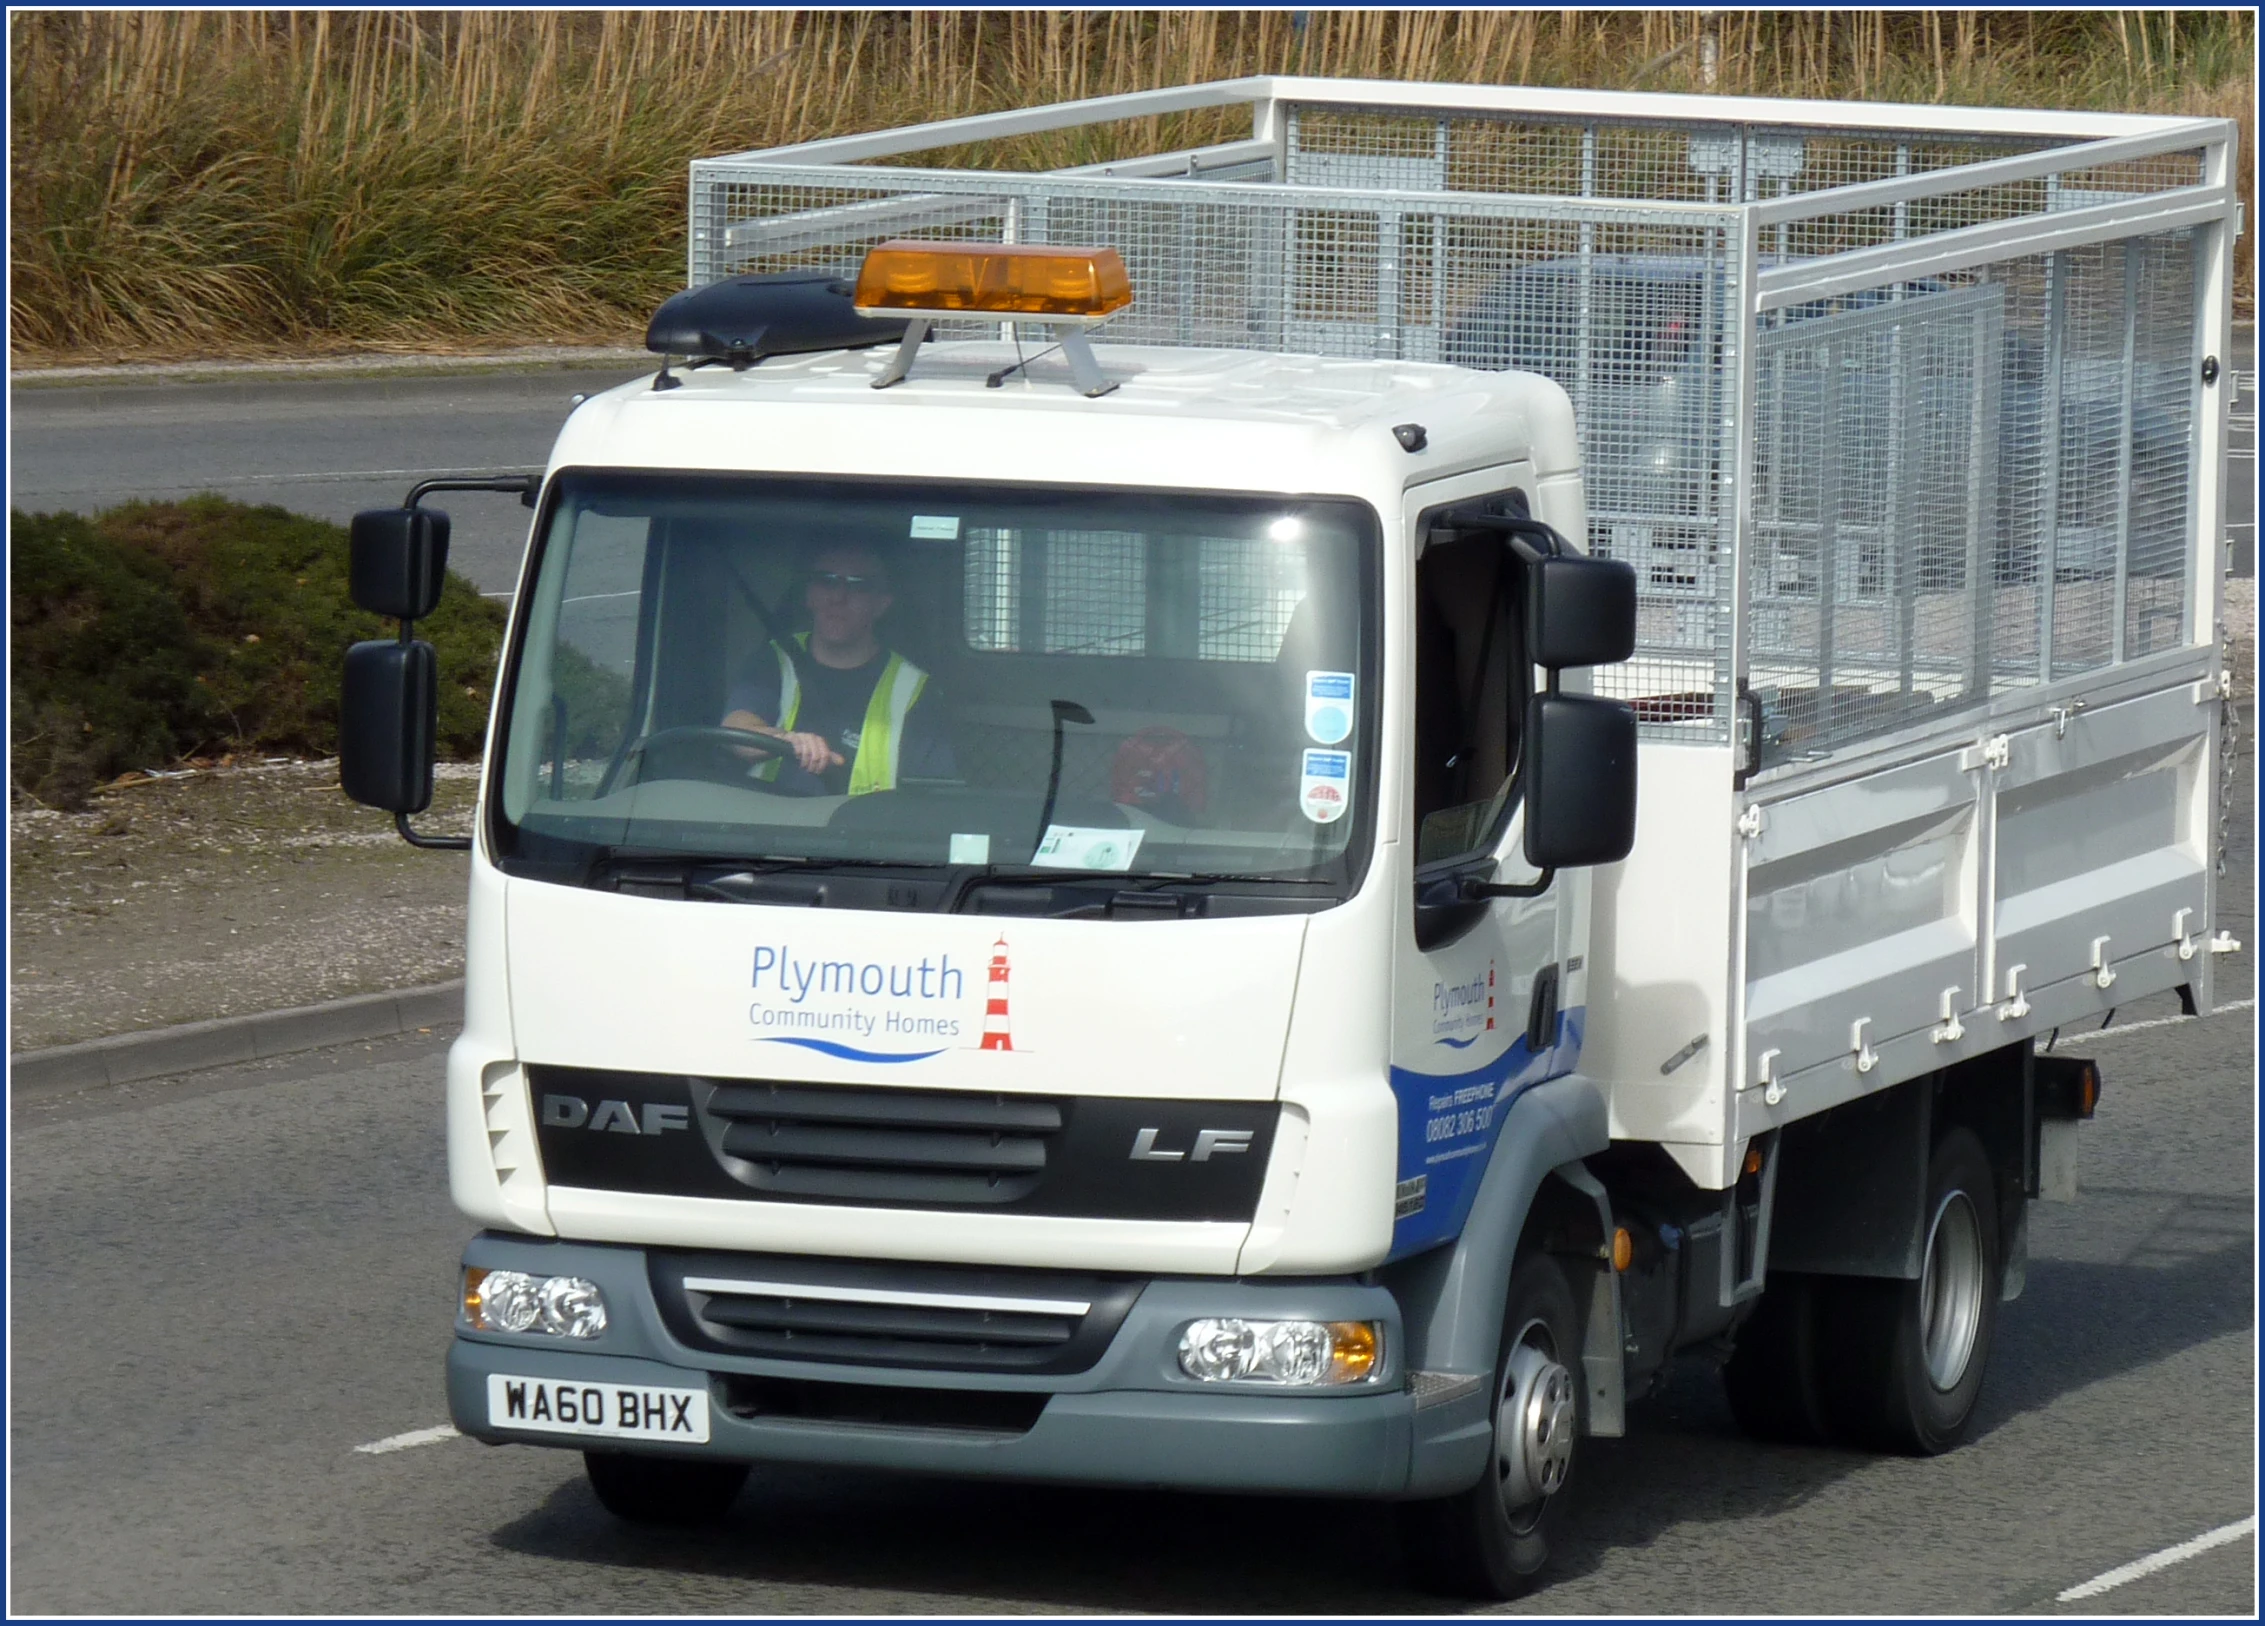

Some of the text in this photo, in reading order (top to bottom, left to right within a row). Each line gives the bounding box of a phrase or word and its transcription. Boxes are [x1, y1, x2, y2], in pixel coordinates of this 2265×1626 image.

[751, 945, 963, 1003] Plymouth
[1434, 973, 1485, 1017] Plymouth
[749, 1003, 960, 1037] Community Homes
[543, 1094, 689, 1136] DAF
[1429, 1082, 1495, 1112] Repairs FREEPHONE
[1128, 1128, 1254, 1161] LF
[1426, 1114, 1456, 1143] 08082
[1457, 1109, 1475, 1135] 306
[505, 1381, 693, 1432] WA60 BHX
